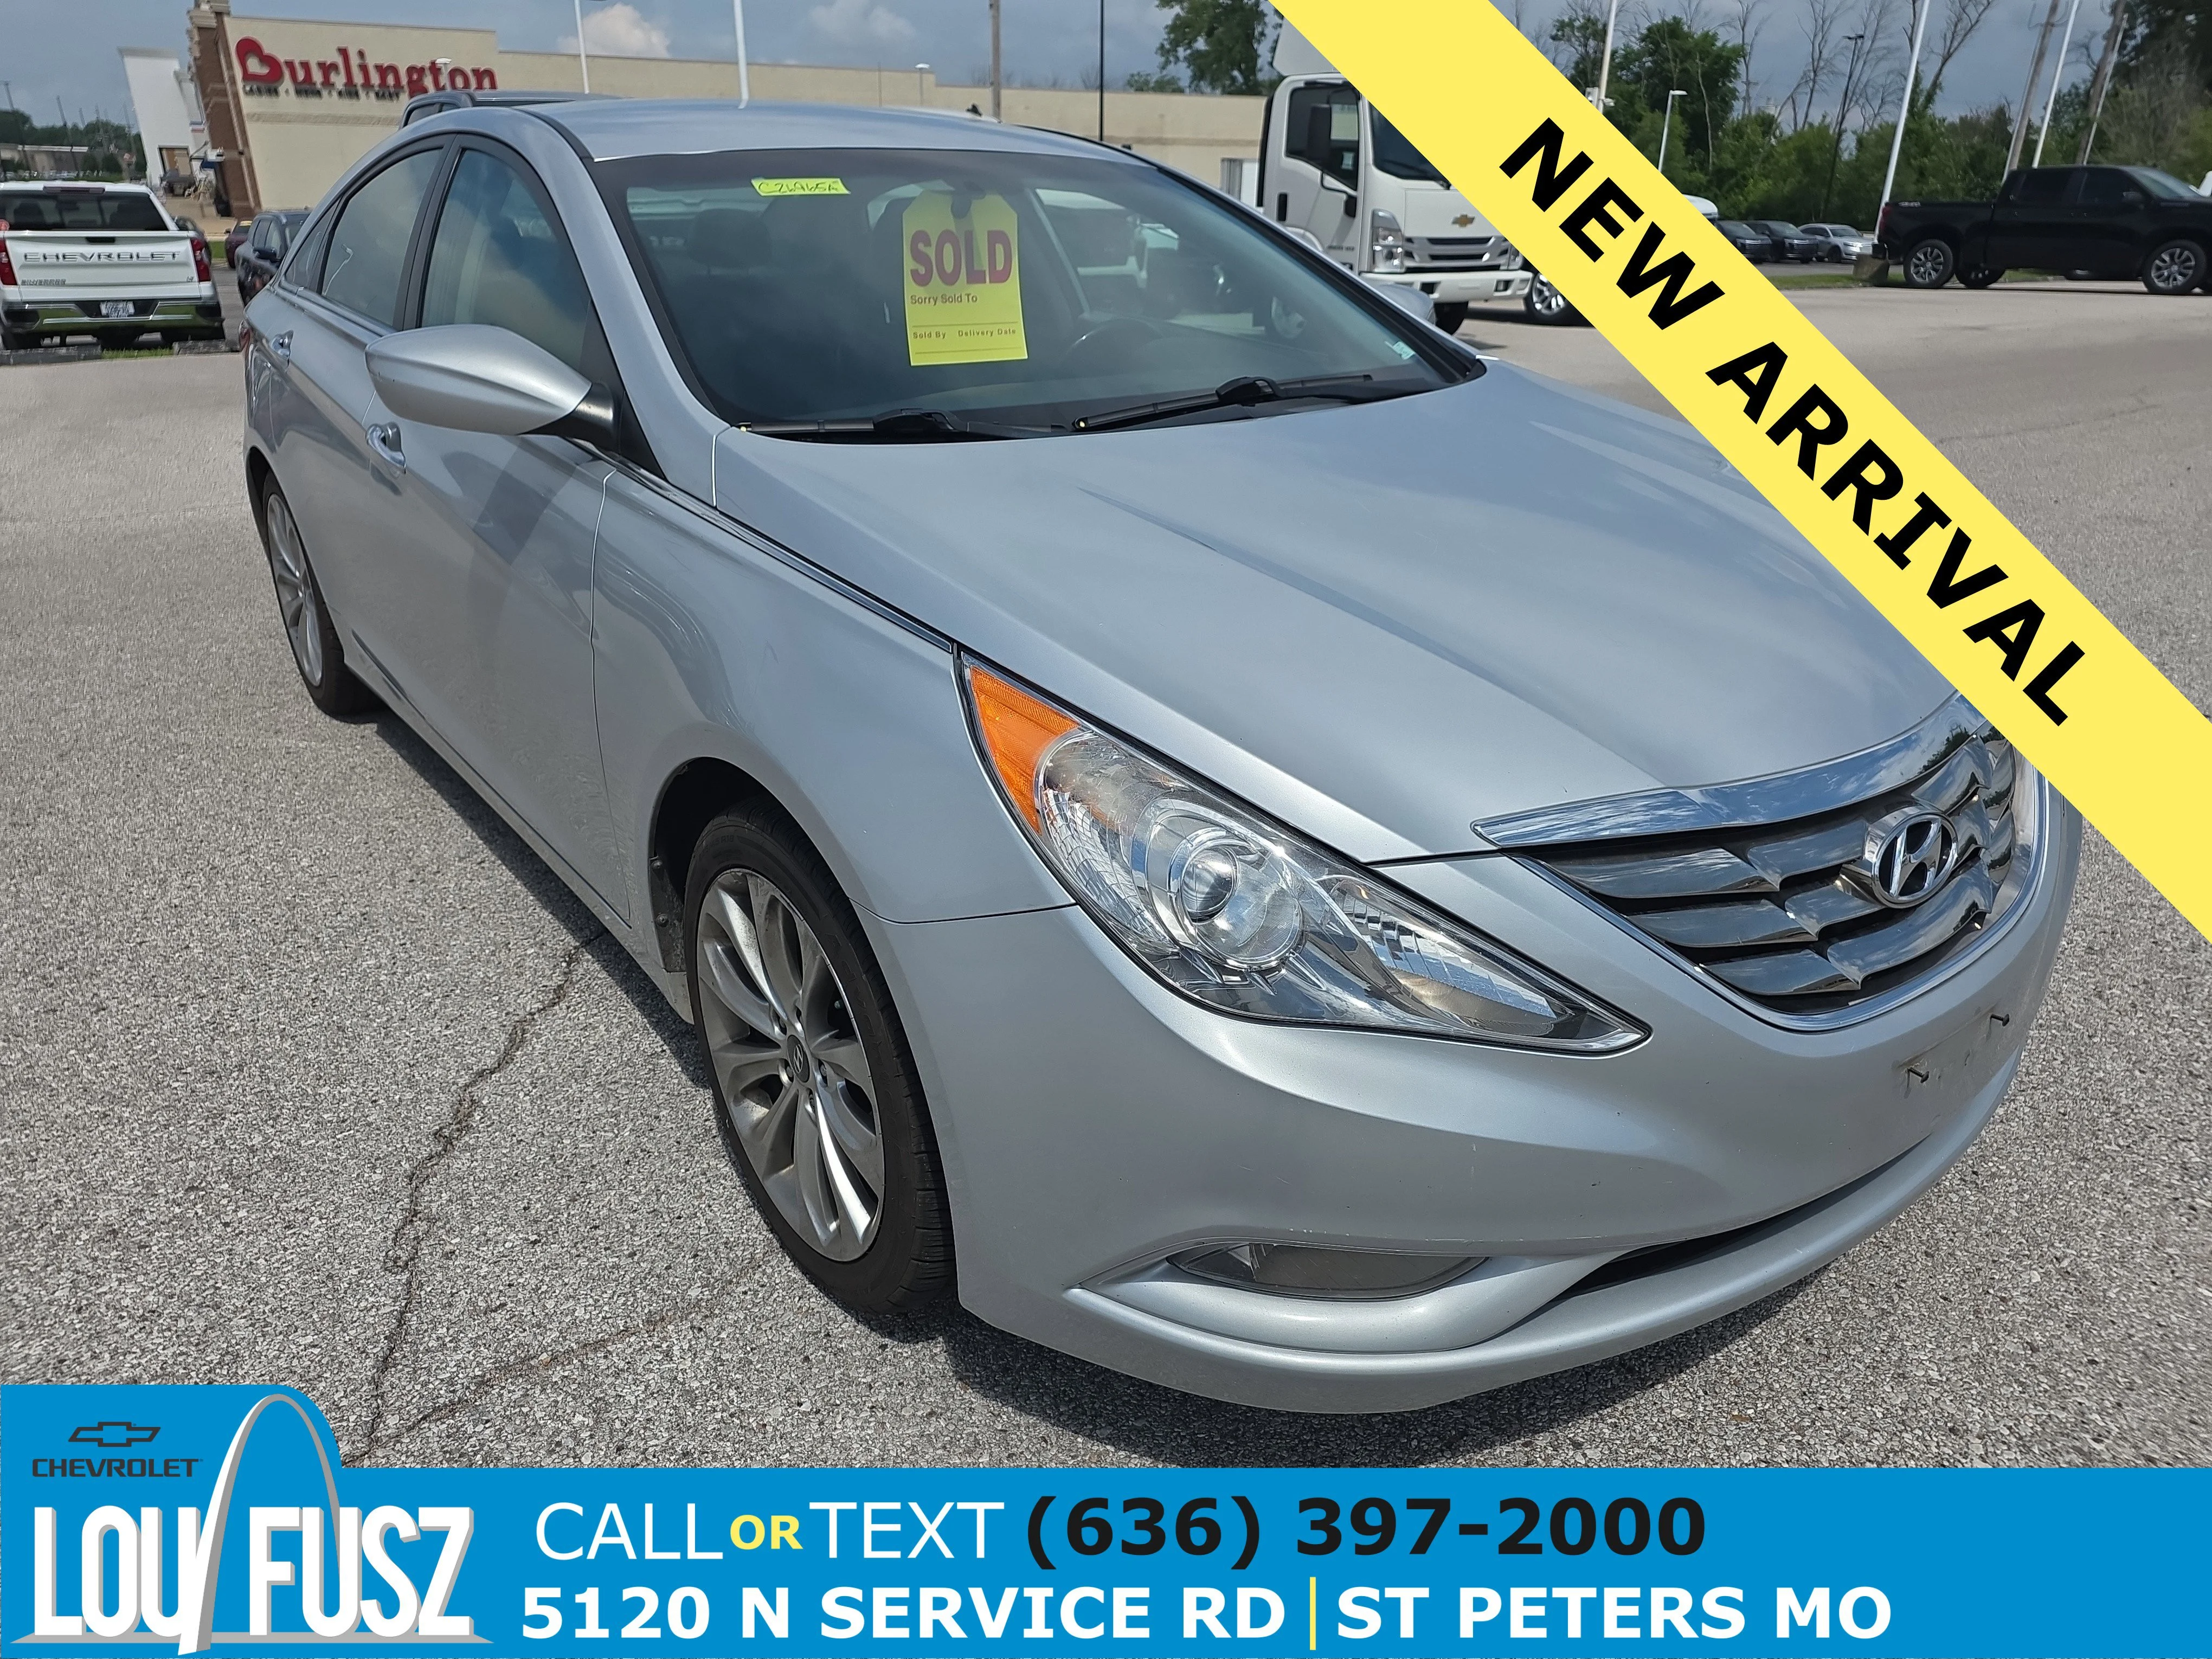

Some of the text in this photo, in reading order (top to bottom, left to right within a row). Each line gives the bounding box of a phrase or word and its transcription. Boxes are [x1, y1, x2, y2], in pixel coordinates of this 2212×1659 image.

[236, 36, 498, 98] Burlington
[24, 252, 181, 263] CHEVROLET
[910, 229, 1012, 287] SOLD
[910, 293, 978, 306] Sorry Sold To
[913, 330, 947, 339] Sold By
[958, 329, 994, 337] Delivery
